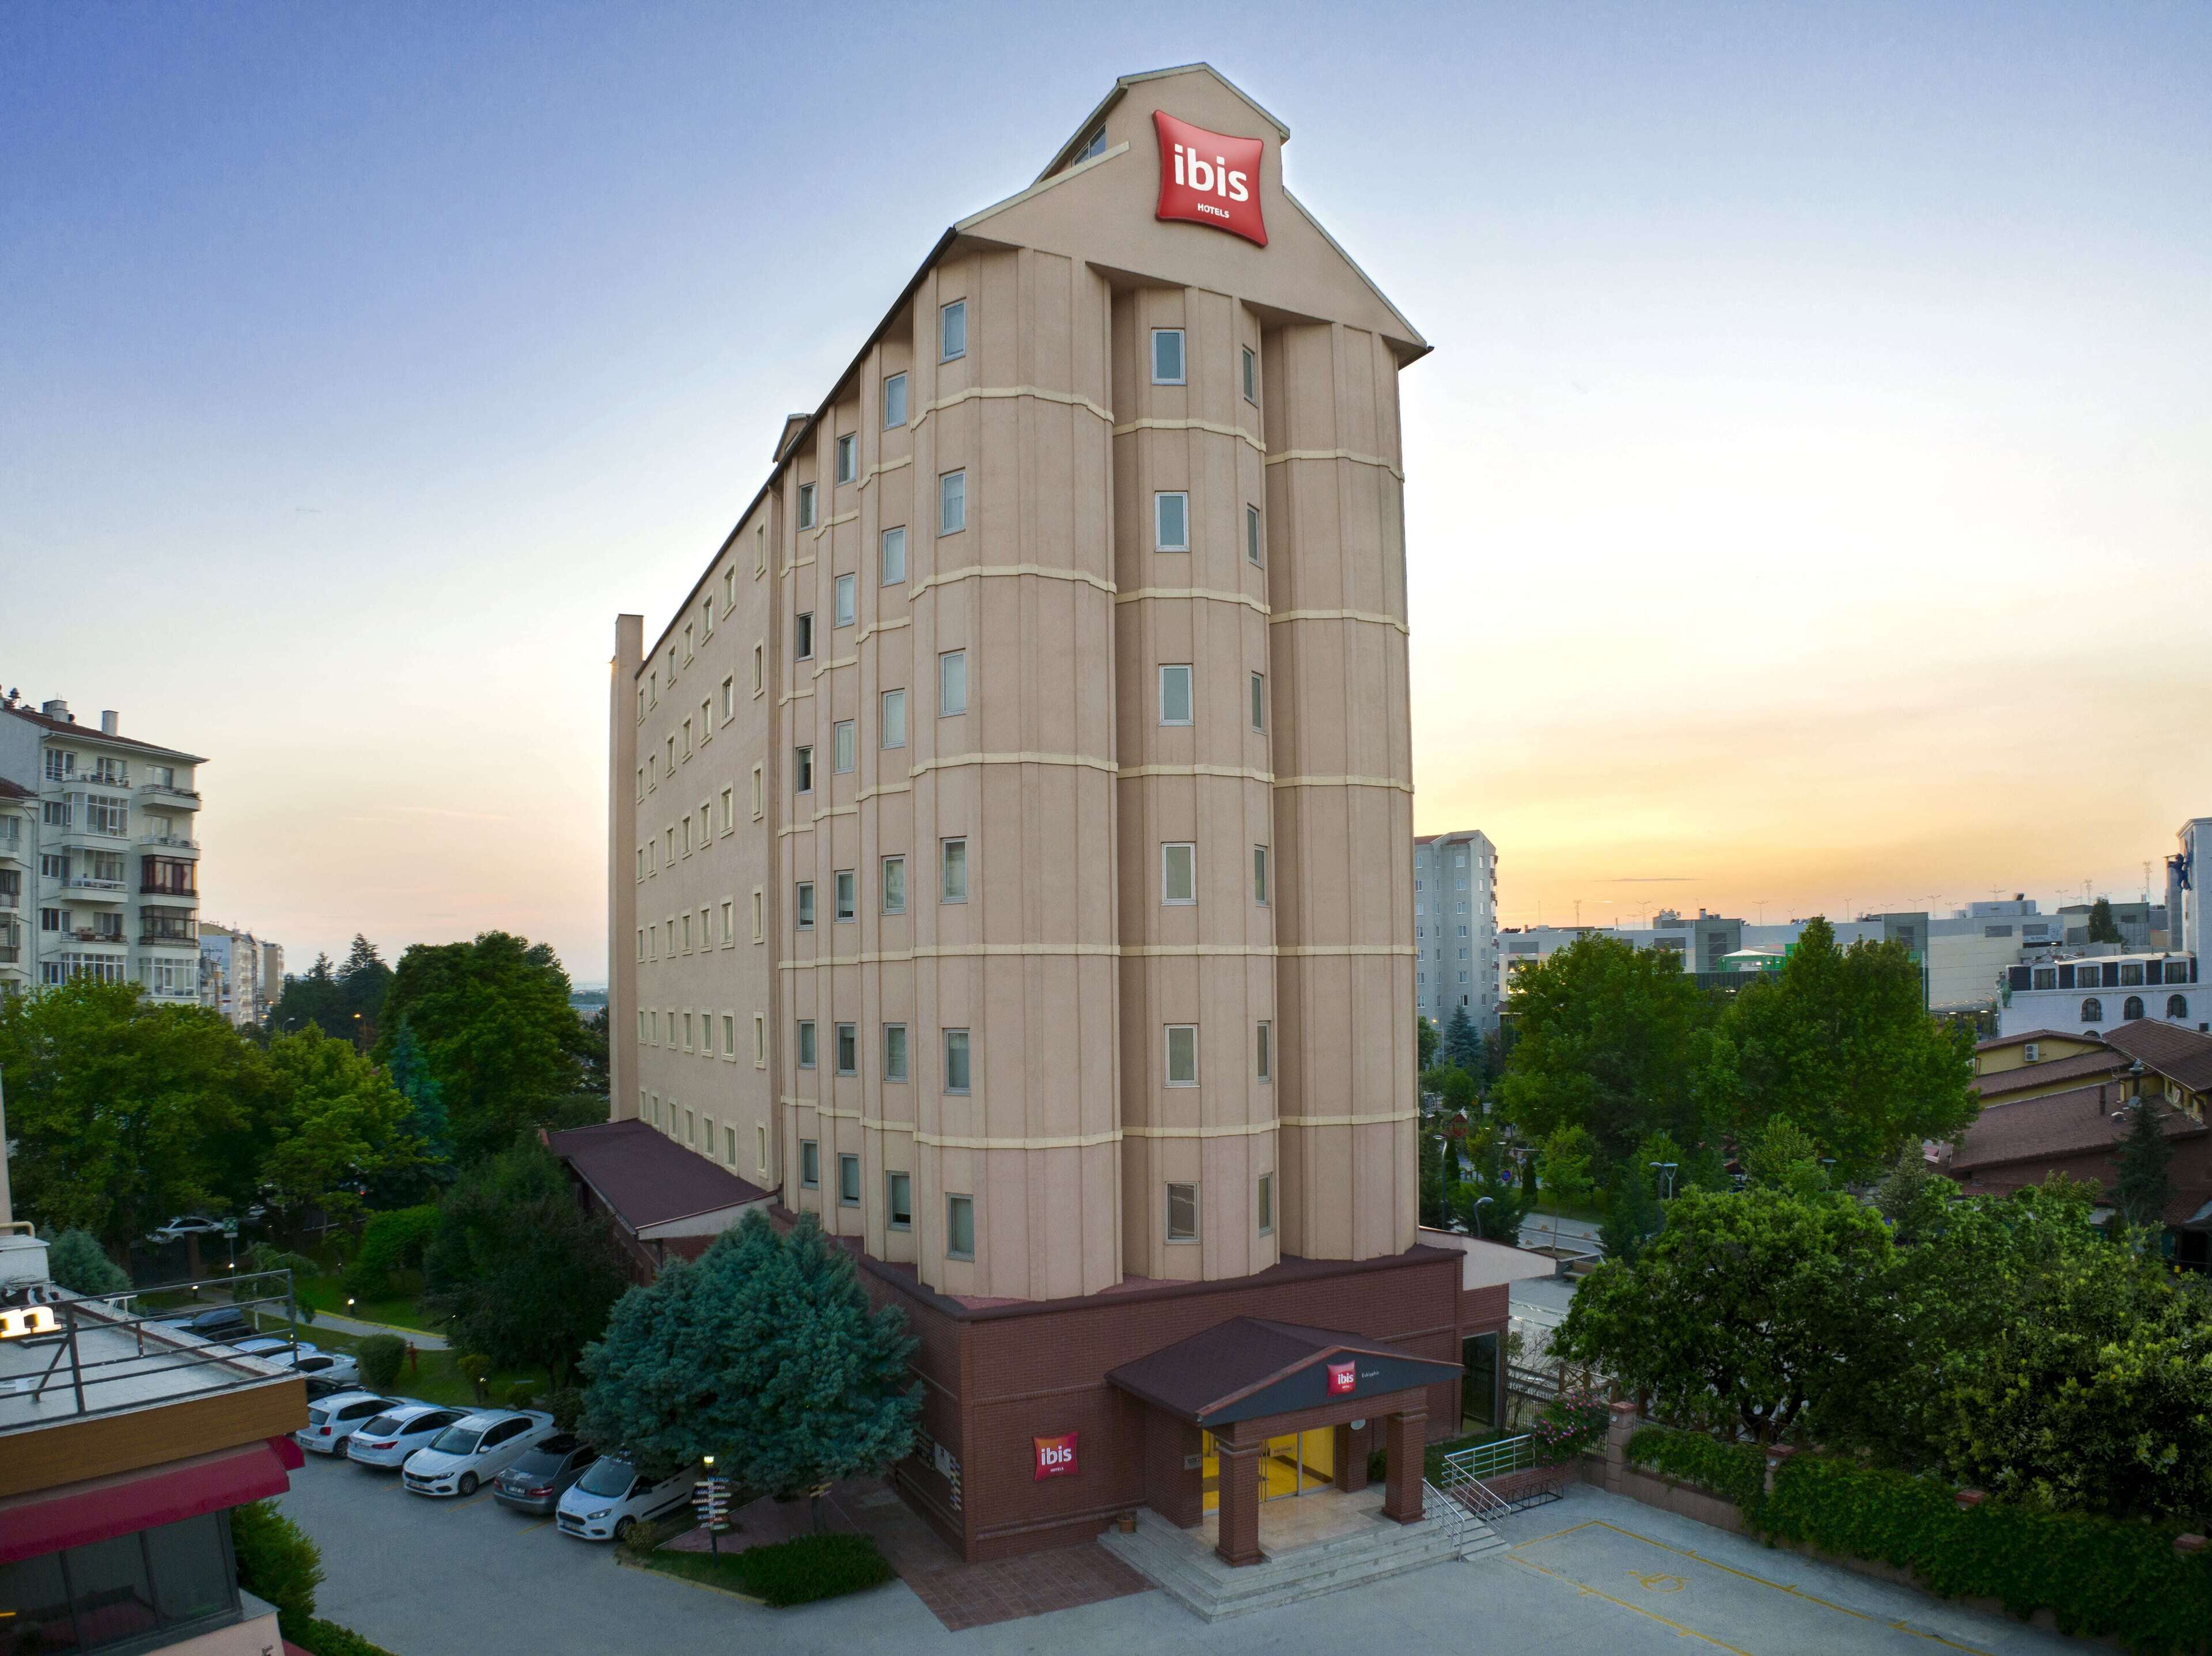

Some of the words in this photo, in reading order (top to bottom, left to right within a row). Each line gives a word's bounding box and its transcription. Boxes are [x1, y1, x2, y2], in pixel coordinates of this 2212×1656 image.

[1174, 143, 1249, 202] ibis
[1198, 203, 1230, 218] HOTELS
[1338, 1372, 1354, 1385] ibis
[1041, 1445, 1071, 1465] ibis
